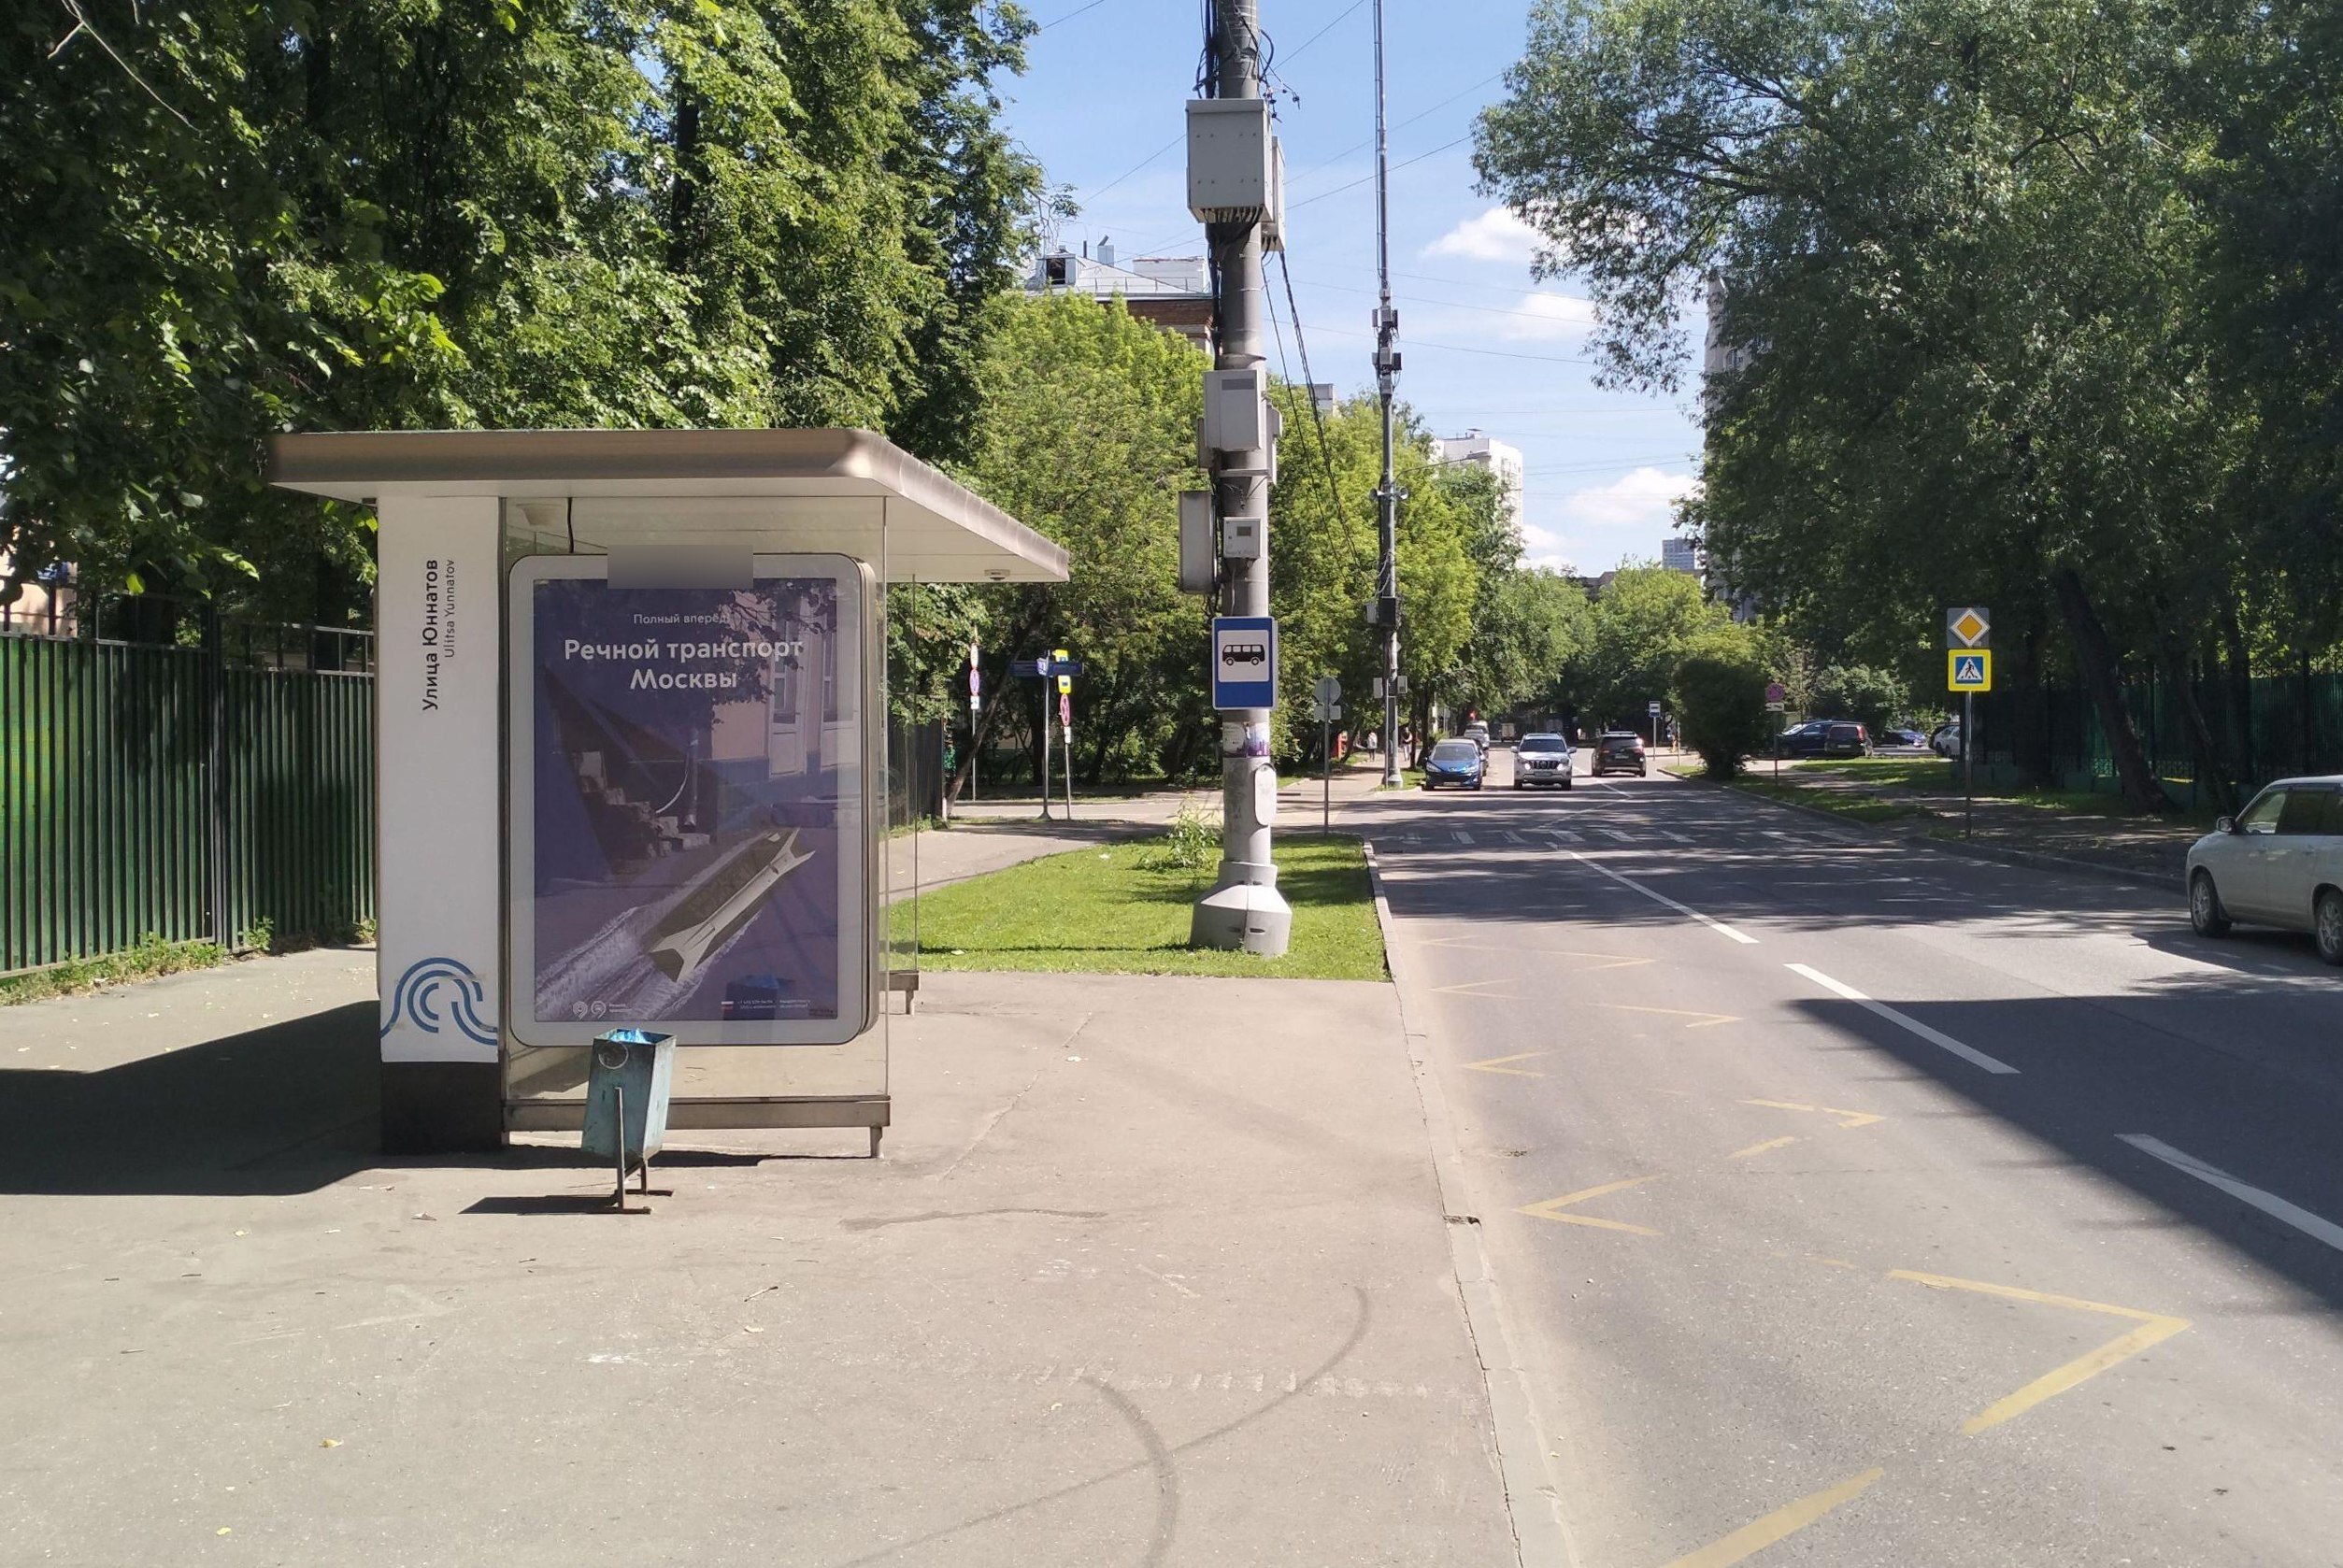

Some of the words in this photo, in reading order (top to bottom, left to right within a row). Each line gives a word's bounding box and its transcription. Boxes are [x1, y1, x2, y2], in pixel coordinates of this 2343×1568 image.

[422, 560, 438, 646] Юннатов
[445, 559, 455, 617] Yunnatov
[634, 613, 680, 624] Полный
[443, 620, 455, 658] Ulitsa
[564, 638, 659, 660] Речной
[666, 641, 803, 663] транспорт
[422, 652, 440, 710] Улица
[630, 668, 737, 689] Москвы
